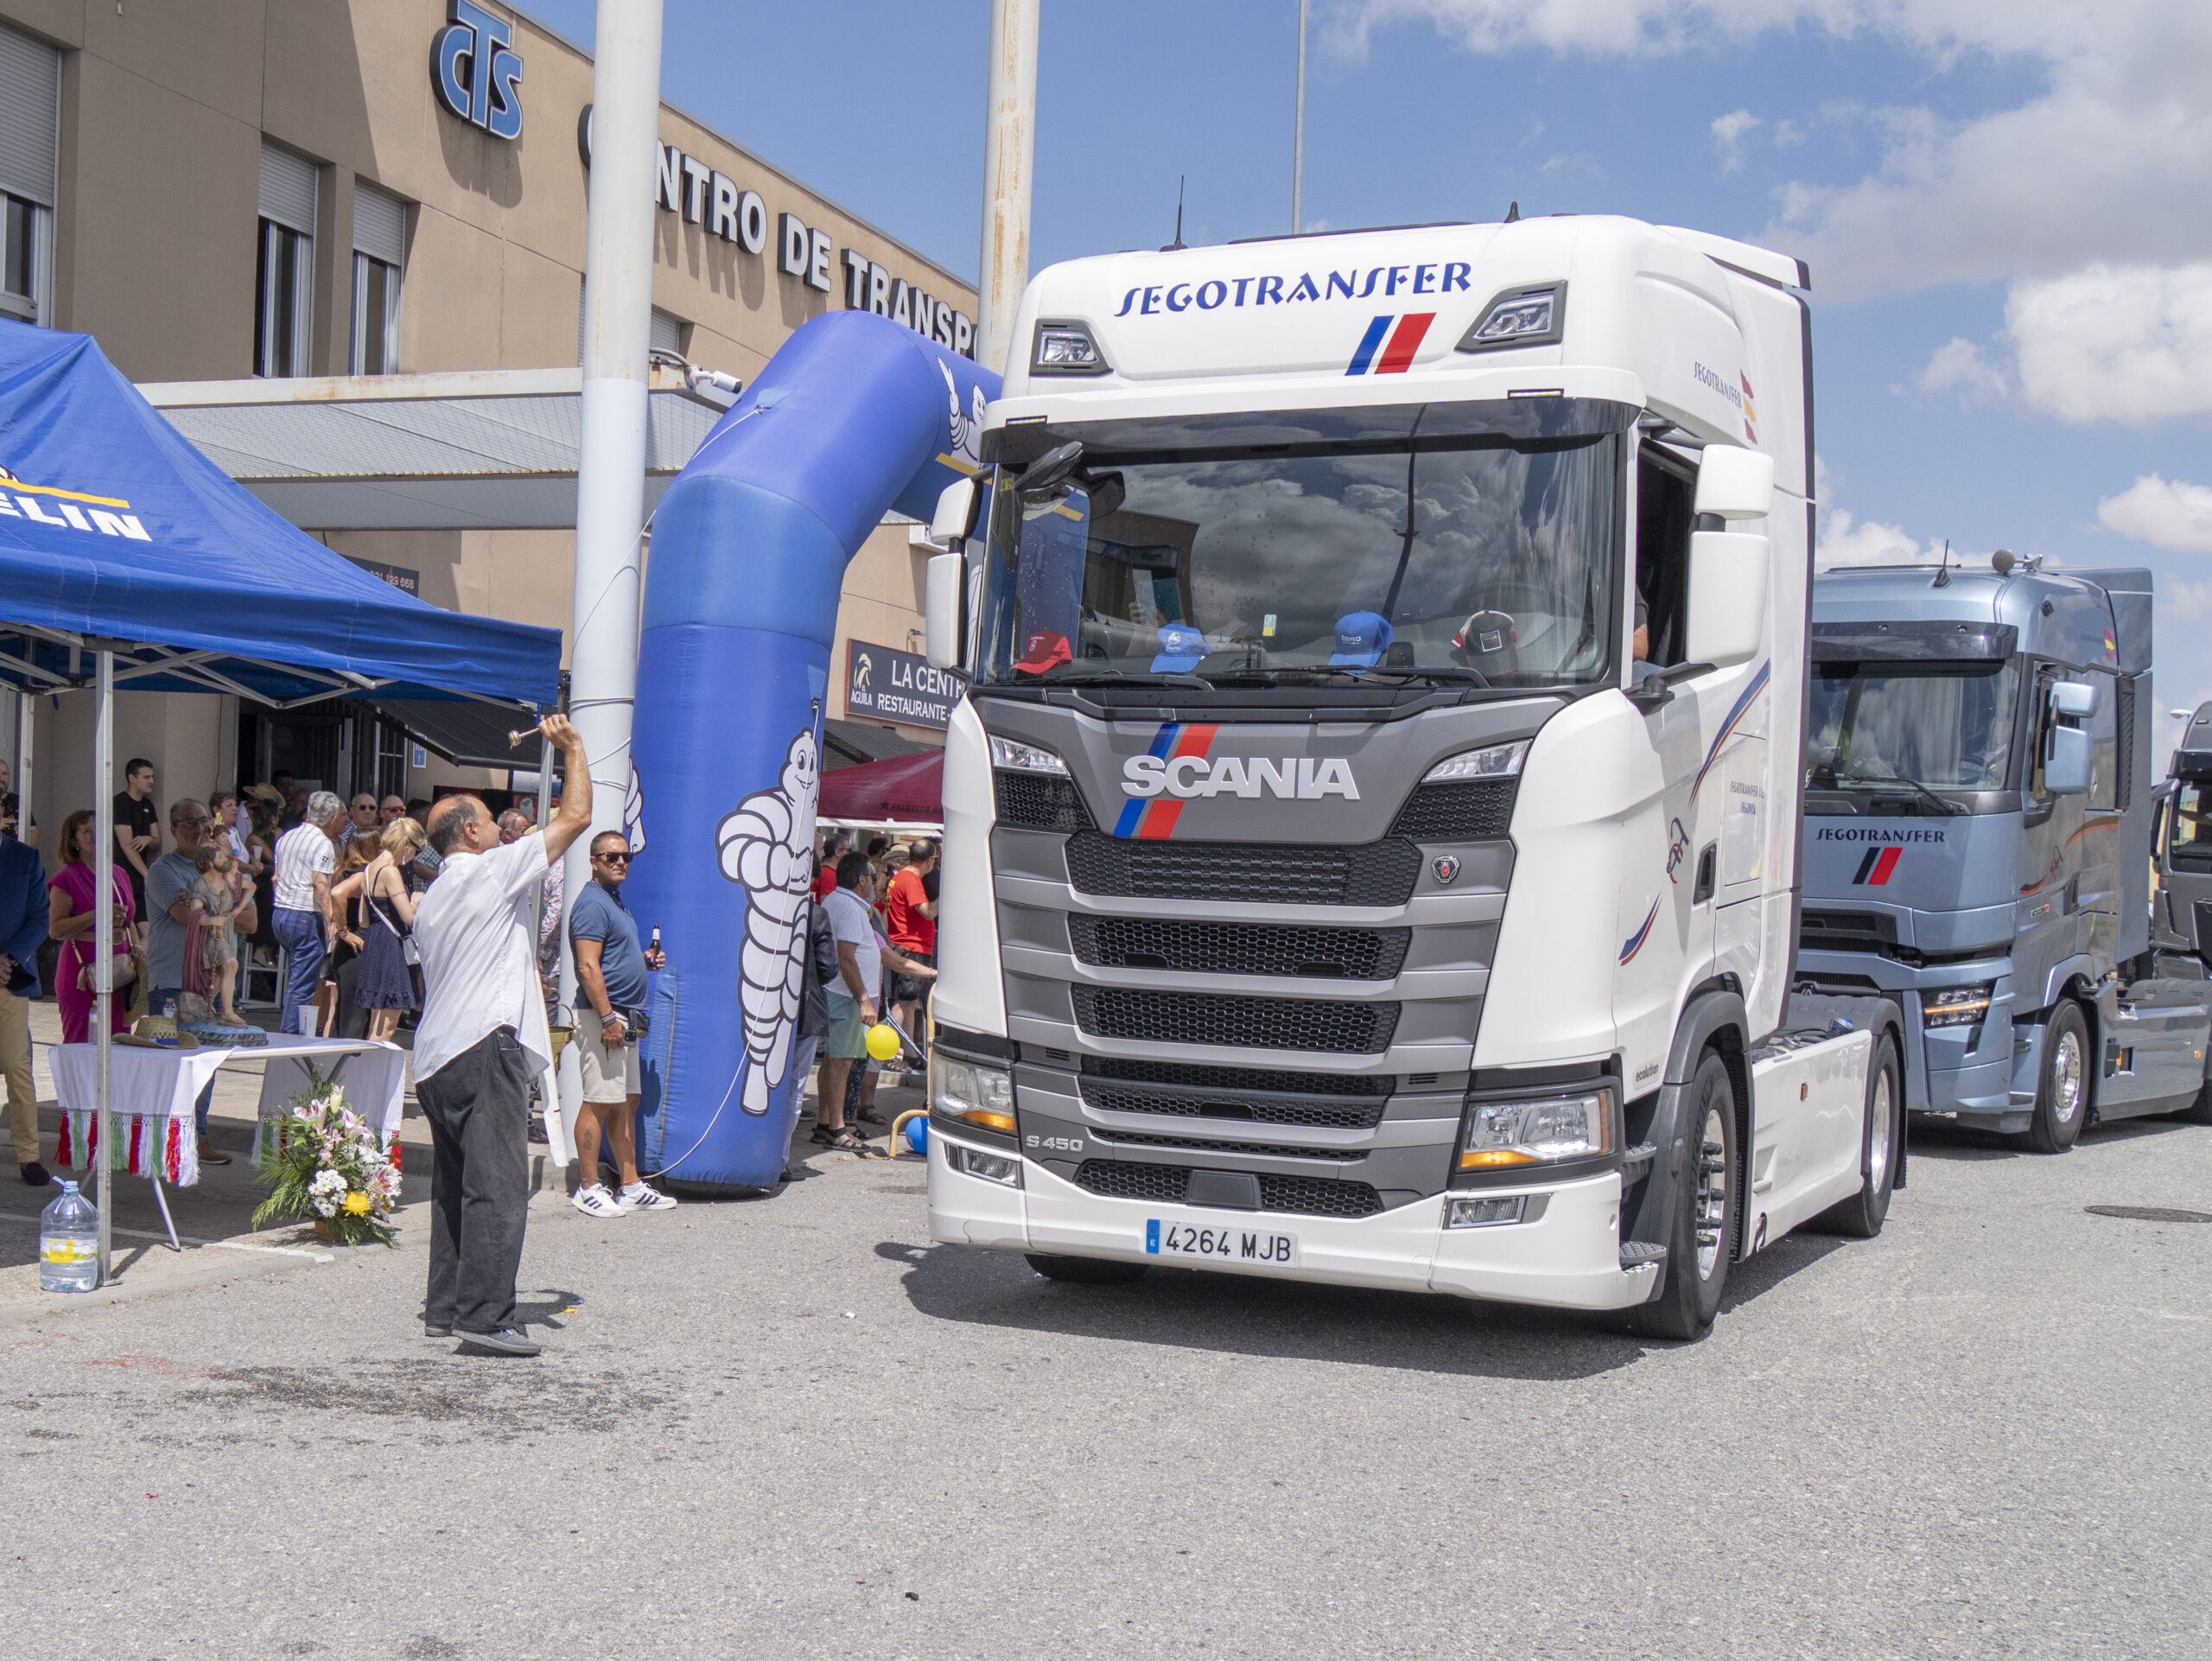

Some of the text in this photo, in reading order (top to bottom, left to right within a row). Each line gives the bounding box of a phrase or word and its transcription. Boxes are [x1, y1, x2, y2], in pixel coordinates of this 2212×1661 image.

[431, 0, 524, 140] CTS
[779, 213, 831, 293] DE
[1114, 262, 1471, 317] SEGOTRANSFER
[1694, 361, 1742, 409] SEGOTRANSFER
[400, 577, 414, 589] 668
[892, 659, 912, 689] LA
[878, 692, 947, 722] RESTAURANTE
[1121, 754, 1361, 800] SCANIA
[1816, 828, 1945, 843] SEGOTRANSFER
[1026, 1135, 1083, 1152] S 450
[1149, 1226, 1291, 1262] E 4264 MJB
